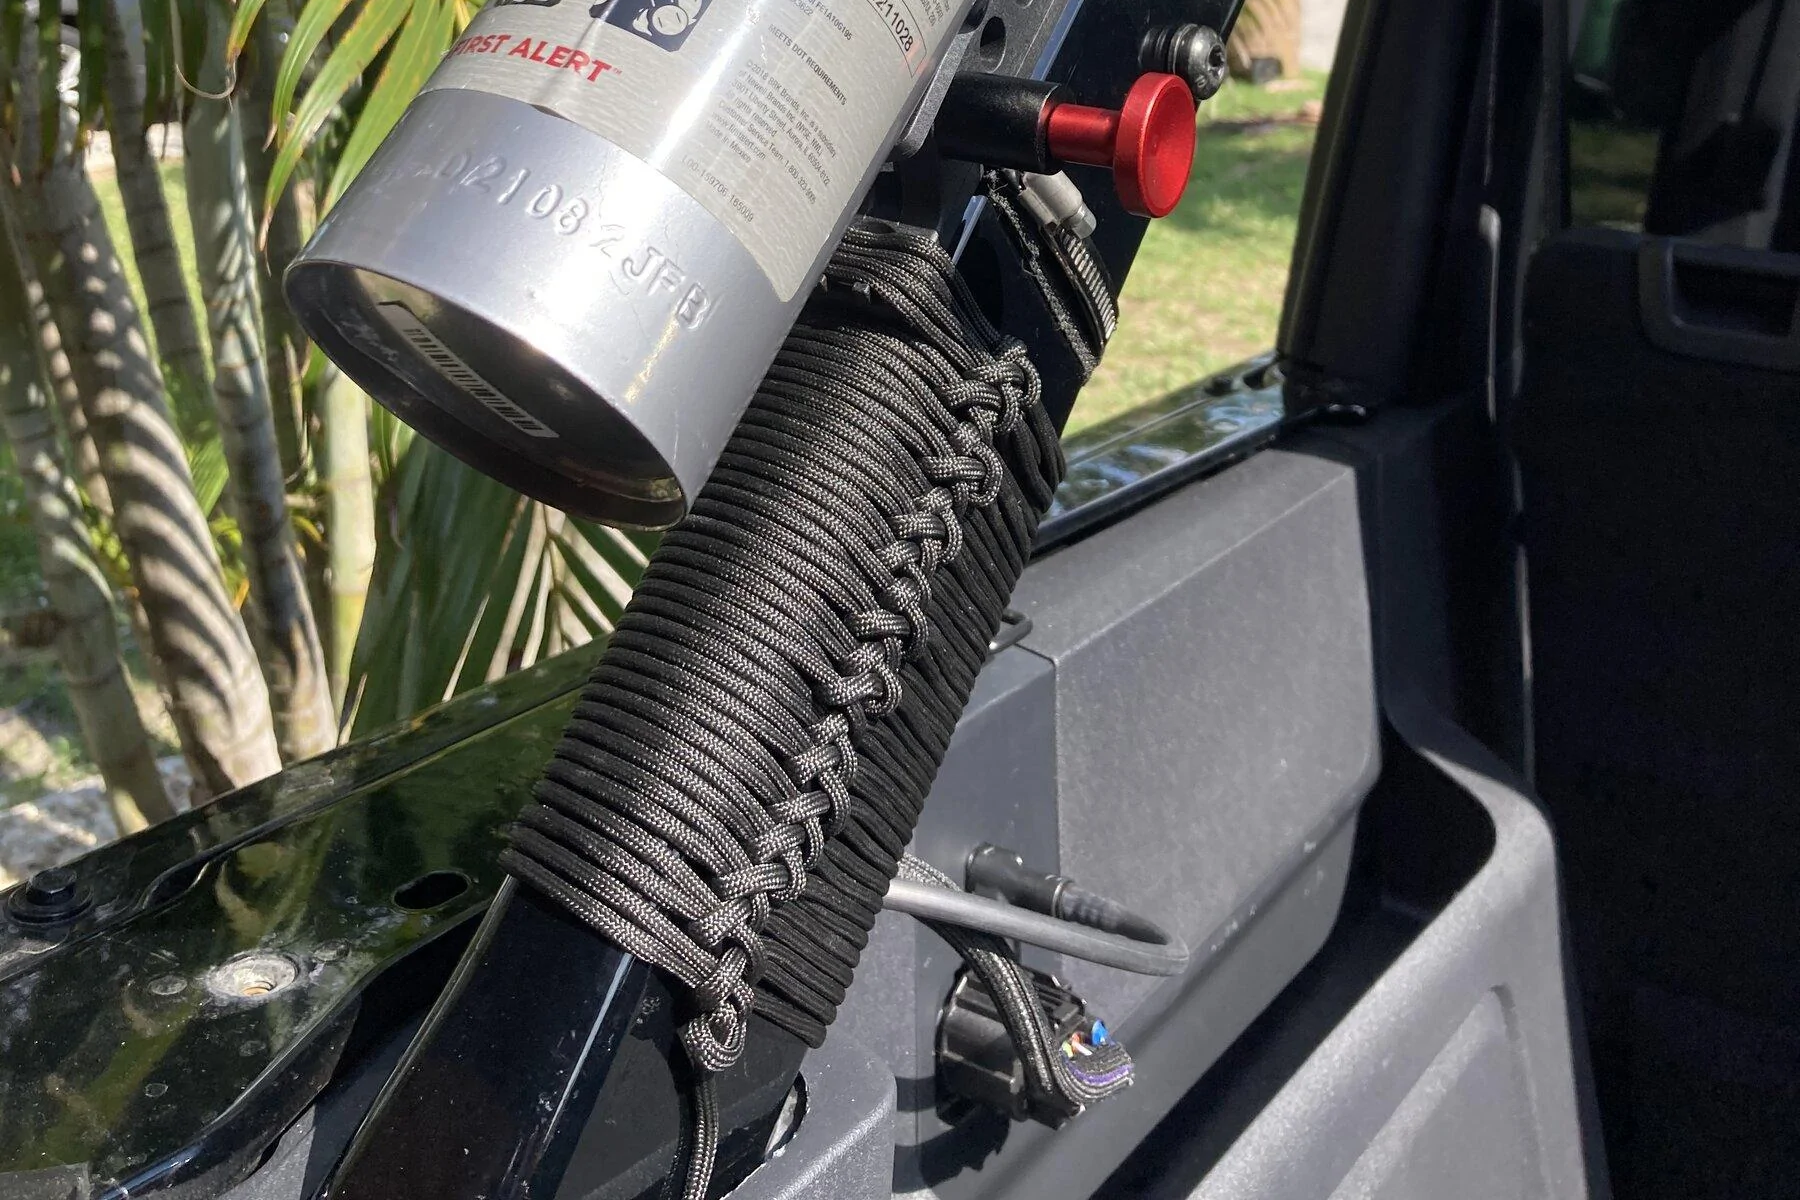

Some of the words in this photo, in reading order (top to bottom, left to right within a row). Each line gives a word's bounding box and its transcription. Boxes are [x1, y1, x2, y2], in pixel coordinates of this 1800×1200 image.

[767, 24, 792, 47] MEETS
[792, 44, 806, 60] DOT
[805, 57, 846, 106] REQUIREMENTS
[748, 92, 769, 115] Liberty
[747, 123, 769, 147] Service
